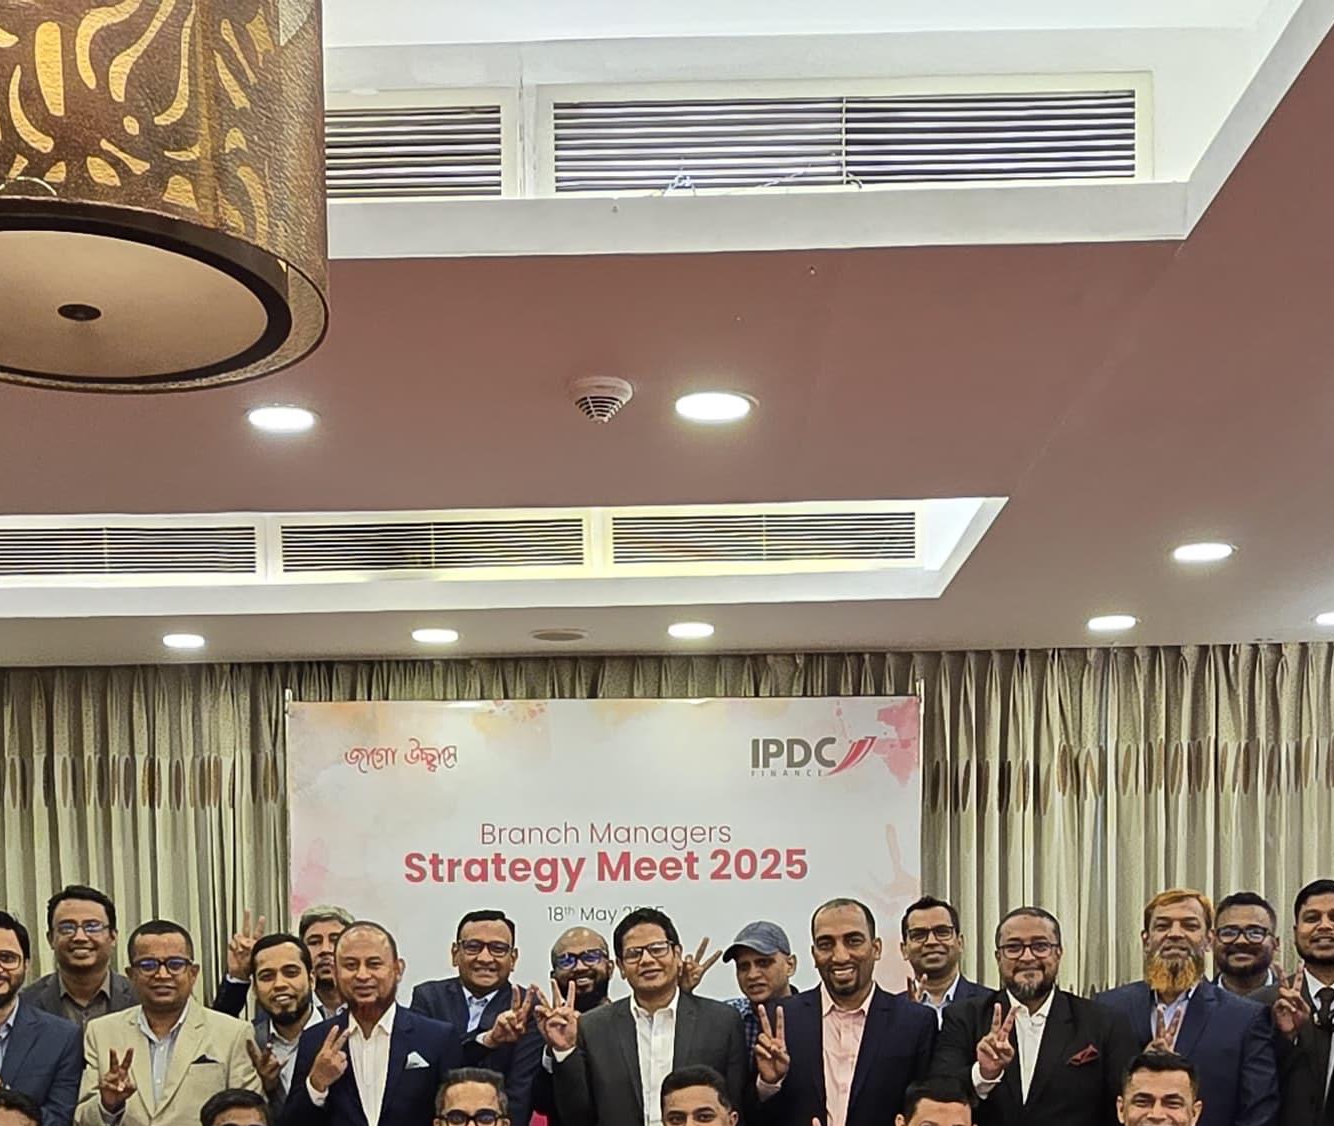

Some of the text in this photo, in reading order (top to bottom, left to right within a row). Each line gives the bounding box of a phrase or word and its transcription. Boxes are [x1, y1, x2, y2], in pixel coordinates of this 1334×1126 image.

[344, 747, 397, 774] জাগো
[751, 737, 837, 769] IPDC
[750, 769, 823, 777] FINANCE
[481, 822, 732, 851] Branch Managers
[403, 848, 809, 893] Strategy Meet 2025
[548, 906, 575, 921] 18th
[580, 907, 617, 925] May
